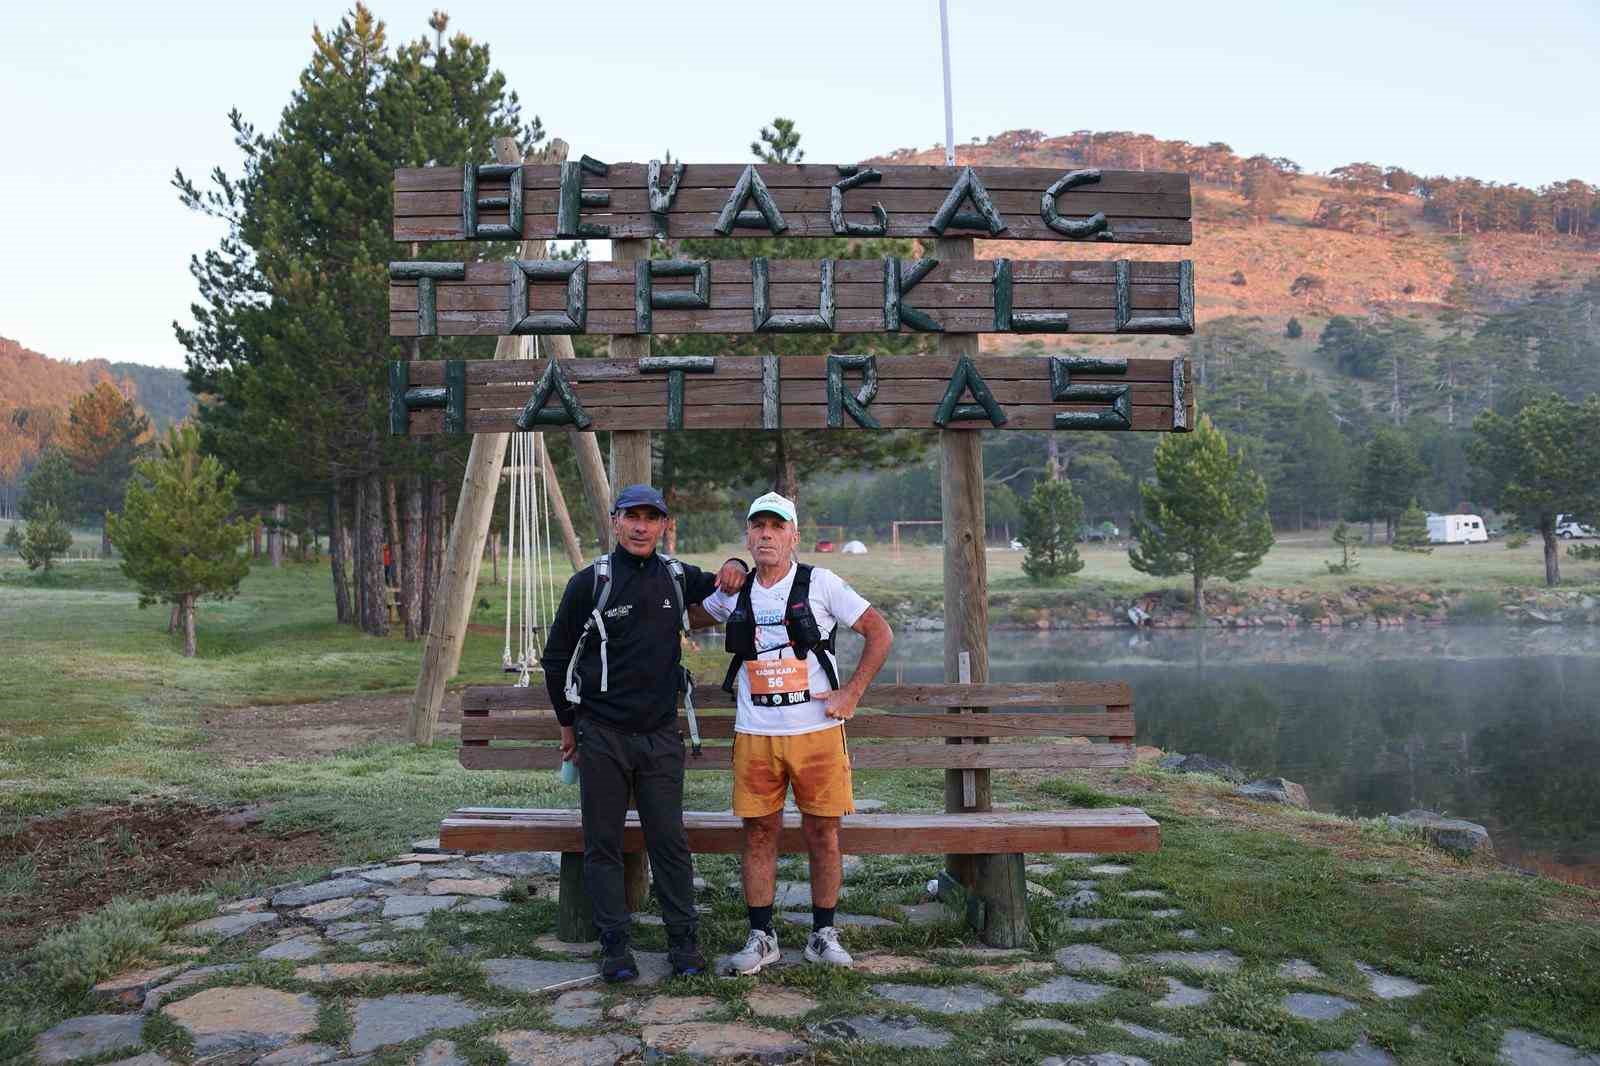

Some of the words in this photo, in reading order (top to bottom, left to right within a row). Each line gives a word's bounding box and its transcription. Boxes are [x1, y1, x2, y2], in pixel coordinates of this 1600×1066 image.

[389, 256, 1194, 336] TOPUKLU
[390, 352, 1187, 434] HATIRASI
[767, 677, 784, 688] 56
[788, 691, 806, 704] 50K
